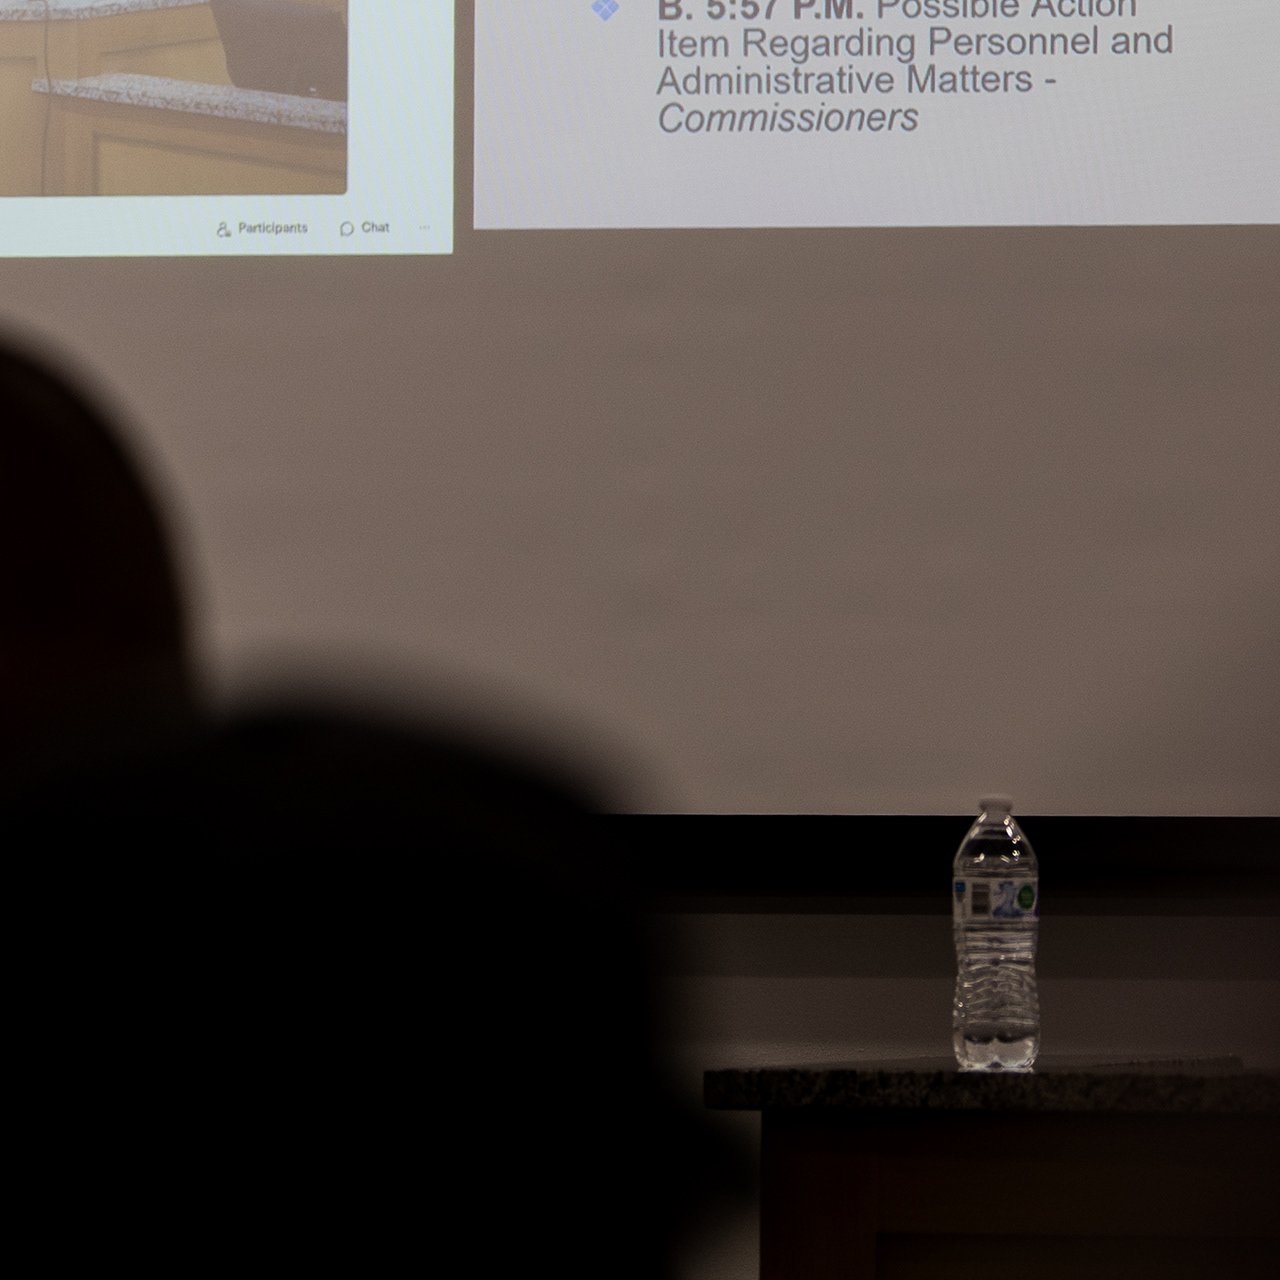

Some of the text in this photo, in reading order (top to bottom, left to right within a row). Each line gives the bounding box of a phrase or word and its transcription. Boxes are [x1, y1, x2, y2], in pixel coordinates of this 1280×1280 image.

[658, 24, 1173, 65] Item Regarding Personnel and
[656, 64, 895, 95] Administrative
[907, 63, 1033, 94] Matters
[658, 102, 919, 134] Commissioners
[238, 223, 308, 235] Participants
[362, 222, 389, 233] Chat
